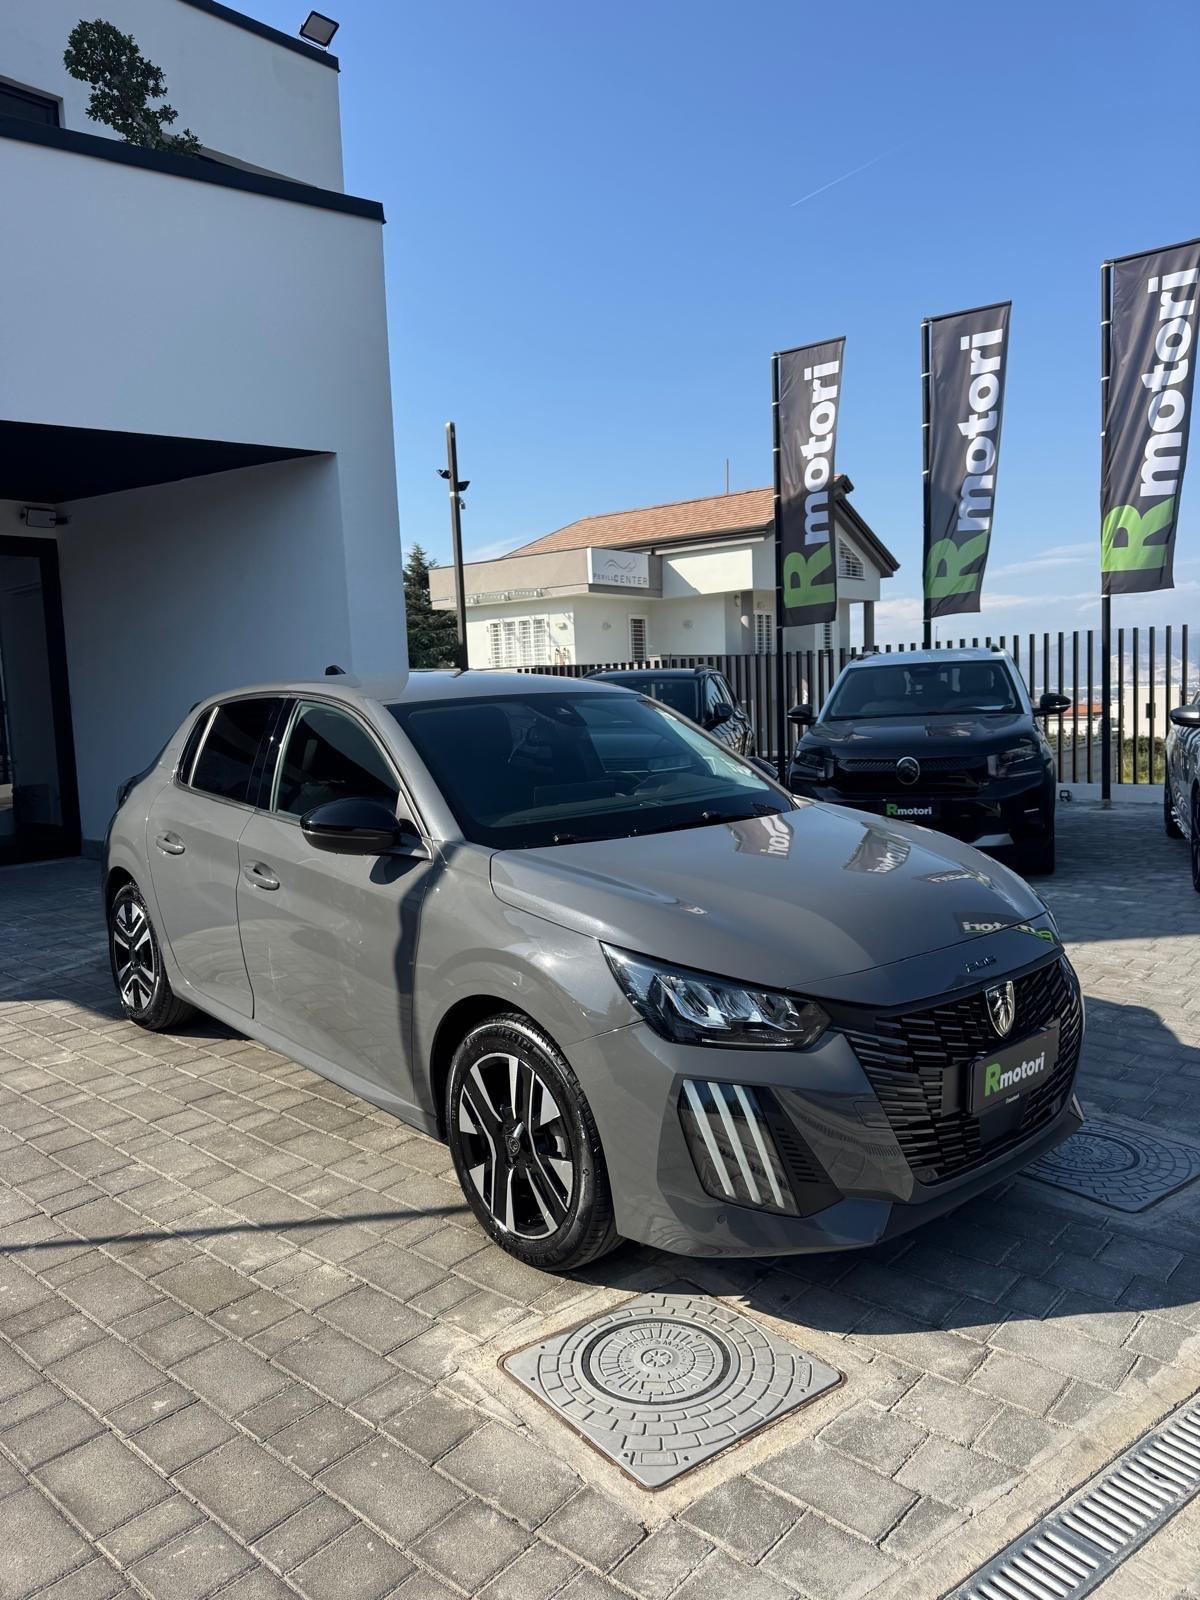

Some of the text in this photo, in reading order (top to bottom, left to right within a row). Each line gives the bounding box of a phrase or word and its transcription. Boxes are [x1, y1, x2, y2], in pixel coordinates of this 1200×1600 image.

[783, 359, 840, 609] Rmotori
[926, 328, 1004, 600] Rmotori
[1101, 267, 1200, 573] Rmotori
[886, 803, 933, 816] Rmotori
[984, 1051, 1045, 1097] Rmotori
